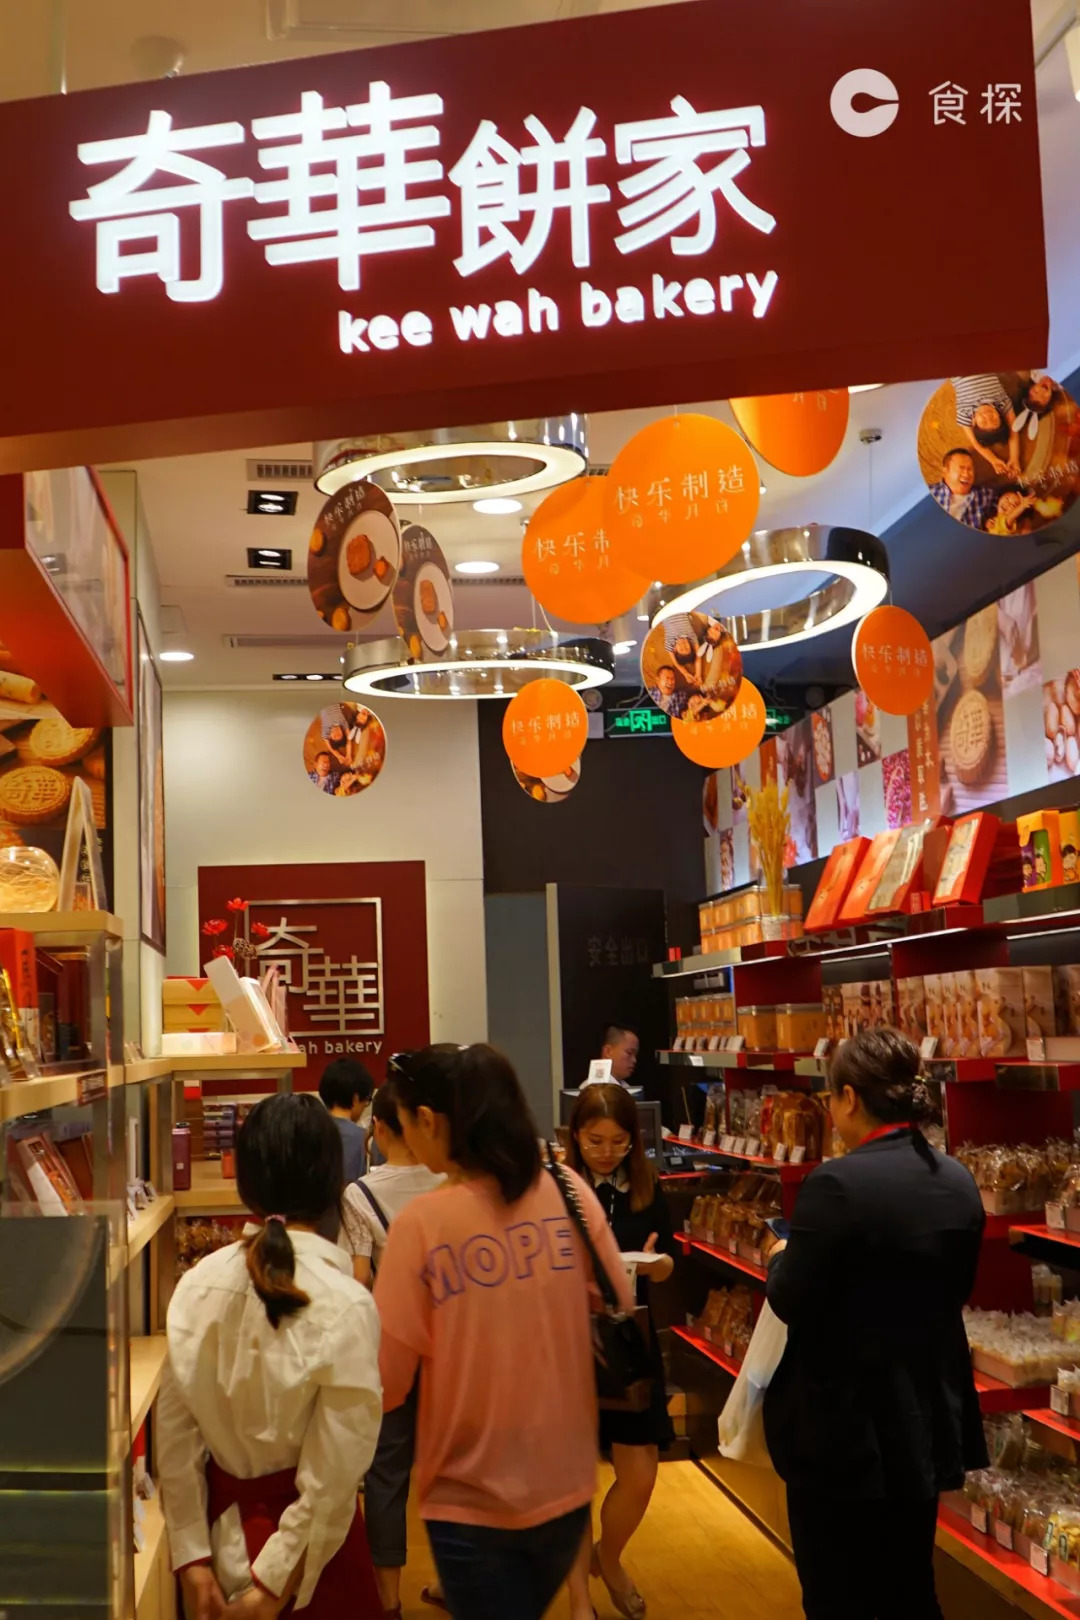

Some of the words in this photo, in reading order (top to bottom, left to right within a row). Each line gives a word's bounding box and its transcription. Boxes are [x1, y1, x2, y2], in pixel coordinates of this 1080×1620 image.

[928, 80, 1022, 125] 食探
[68, 80, 777, 303] 奇華餅家
[338, 310, 433, 354] kee
[449, 287, 559, 341] wah
[580, 269, 779, 327] bakery
[614, 464, 744, 514] 快乐制造
[862, 642, 928, 668] 快乐制造
[511, 710, 580, 736] 快乐制造
[256, 916, 378, 1032] 奇華
[587, 936, 648, 967] 安全出口
[324, 1040, 383, 1055] bakery
